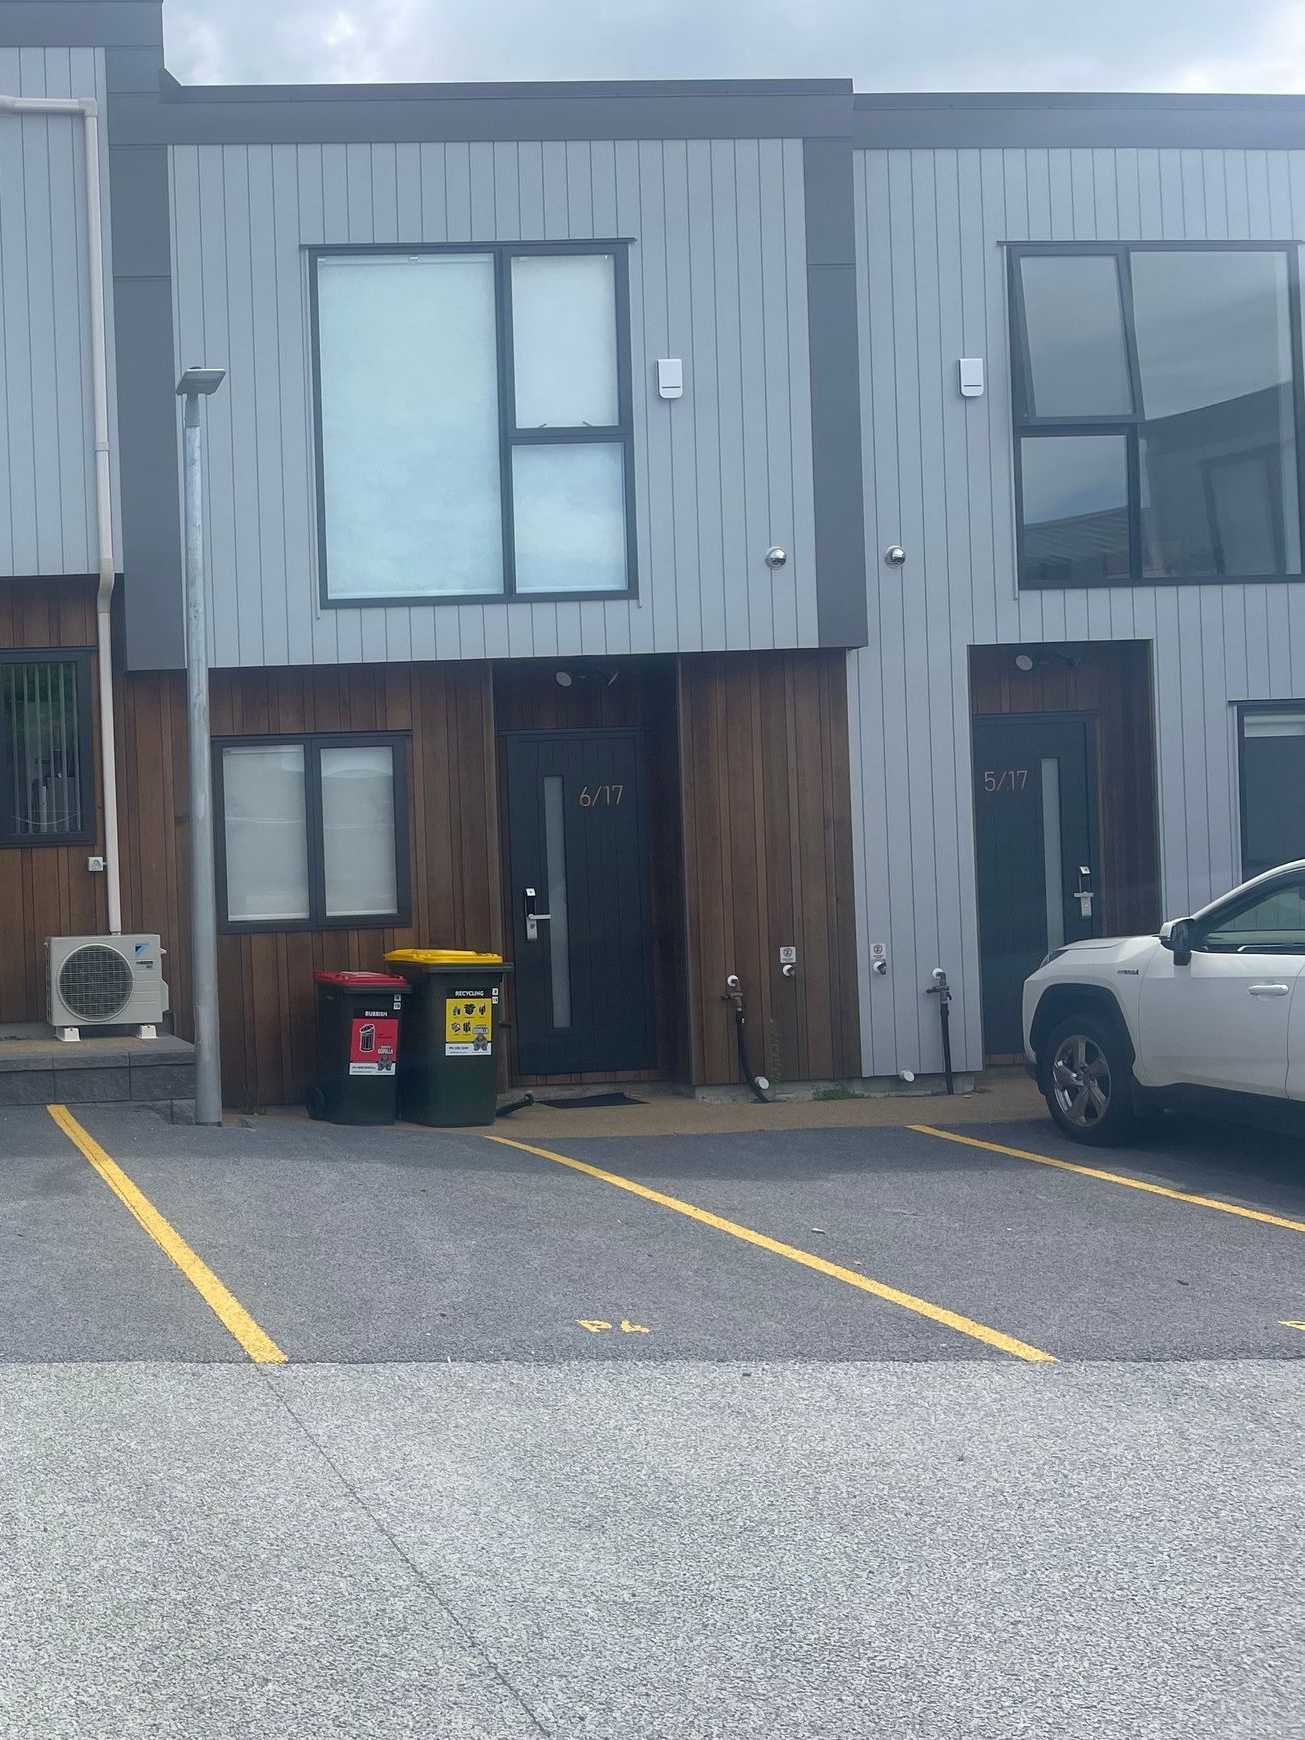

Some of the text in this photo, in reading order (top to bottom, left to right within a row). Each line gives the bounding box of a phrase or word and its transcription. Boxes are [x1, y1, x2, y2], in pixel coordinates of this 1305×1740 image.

[984, 770, 1028, 792] 5/17
[579, 785, 624, 807] 6/17
[575, 1319, 651, 1333] P4
